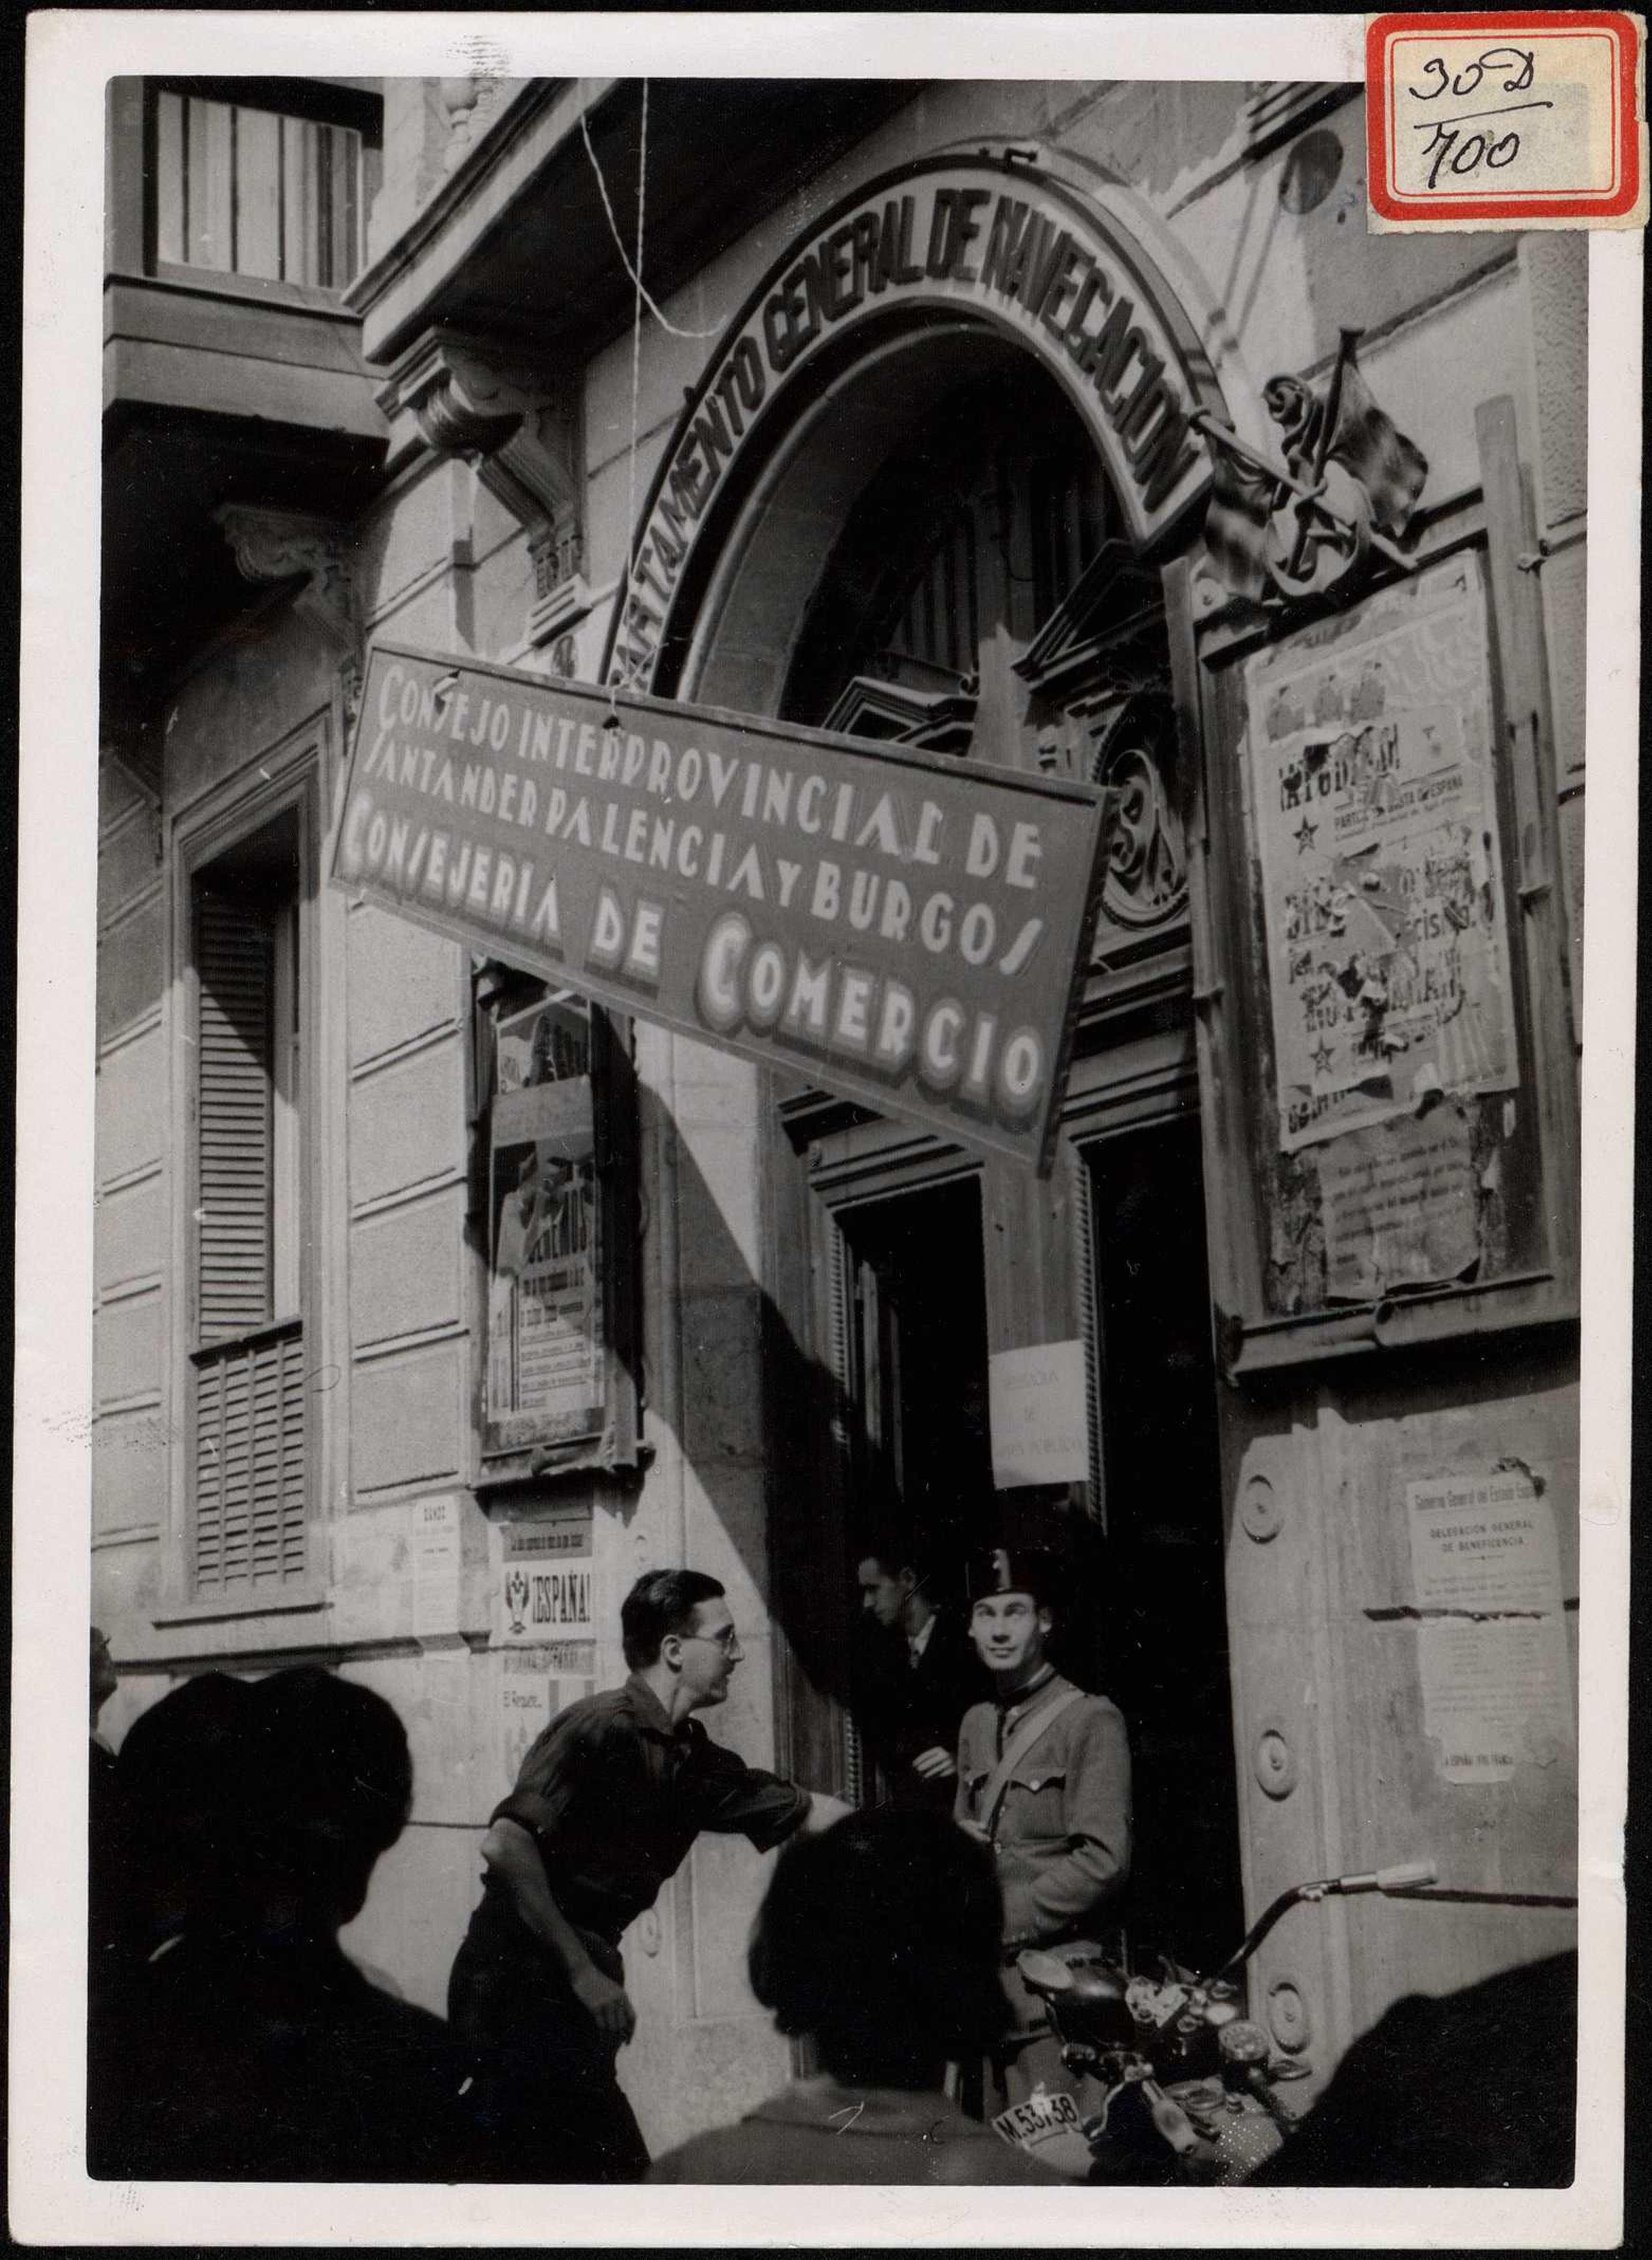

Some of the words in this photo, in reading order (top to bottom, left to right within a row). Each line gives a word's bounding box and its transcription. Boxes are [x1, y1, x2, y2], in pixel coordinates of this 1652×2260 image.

[1421, 123, 1520, 189] 700
[761, 195, 924, 374] GENERAL
[926, 187, 992, 283] DE
[981, 195, 1202, 513] NAVEGACION
[363, 730, 538, 827] SANTANDER
[545, 788, 765, 899] PALENCIA
[778, 859, 802, 908] Y
[810, 860, 1043, 975] BURGOS
[379, 664, 510, 752] CONSEJO
[518, 709, 943, 865] INTERPROVINCIAL
[965, 813, 1042, 889] DE
[344, 789, 561, 944] CONSEJERIA
[591, 888, 664, 970] DE
[700, 912, 1045, 1105] COMERCIO
